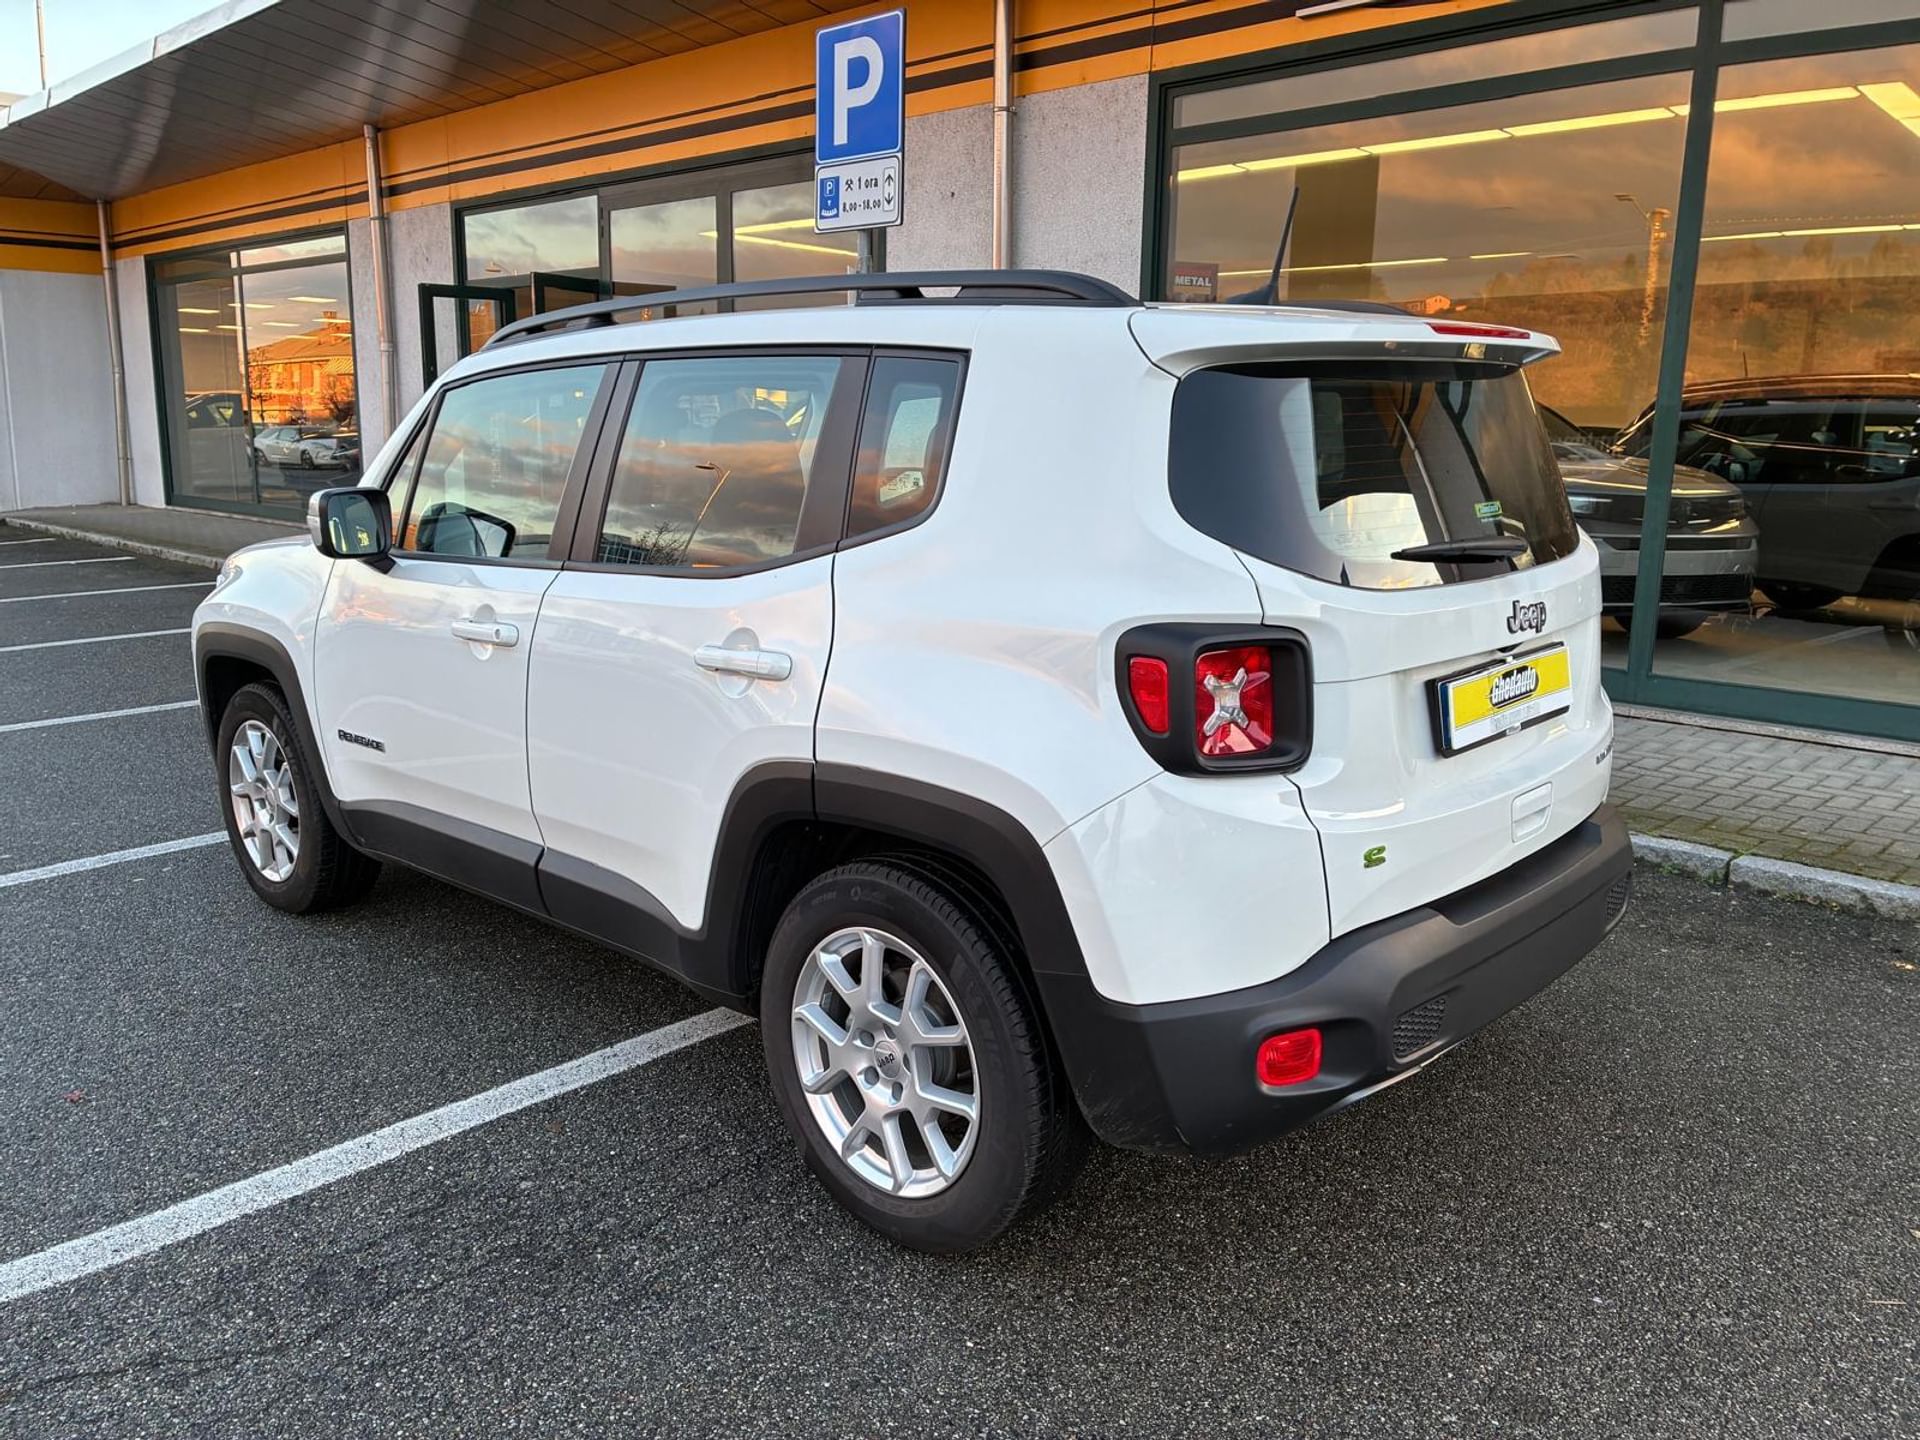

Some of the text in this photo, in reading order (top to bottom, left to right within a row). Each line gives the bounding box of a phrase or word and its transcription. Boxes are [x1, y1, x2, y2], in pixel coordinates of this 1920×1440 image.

[834, 36, 885, 146] P
[826, 181, 833, 195] P
[857, 176, 879, 190] 1 ora
[1175, 275, 1212, 287] METAL
[1507, 600, 1546, 633] Jeep
[1491, 666, 1537, 705] Ghedauto
[878, 1052, 895, 1068] Jeep
